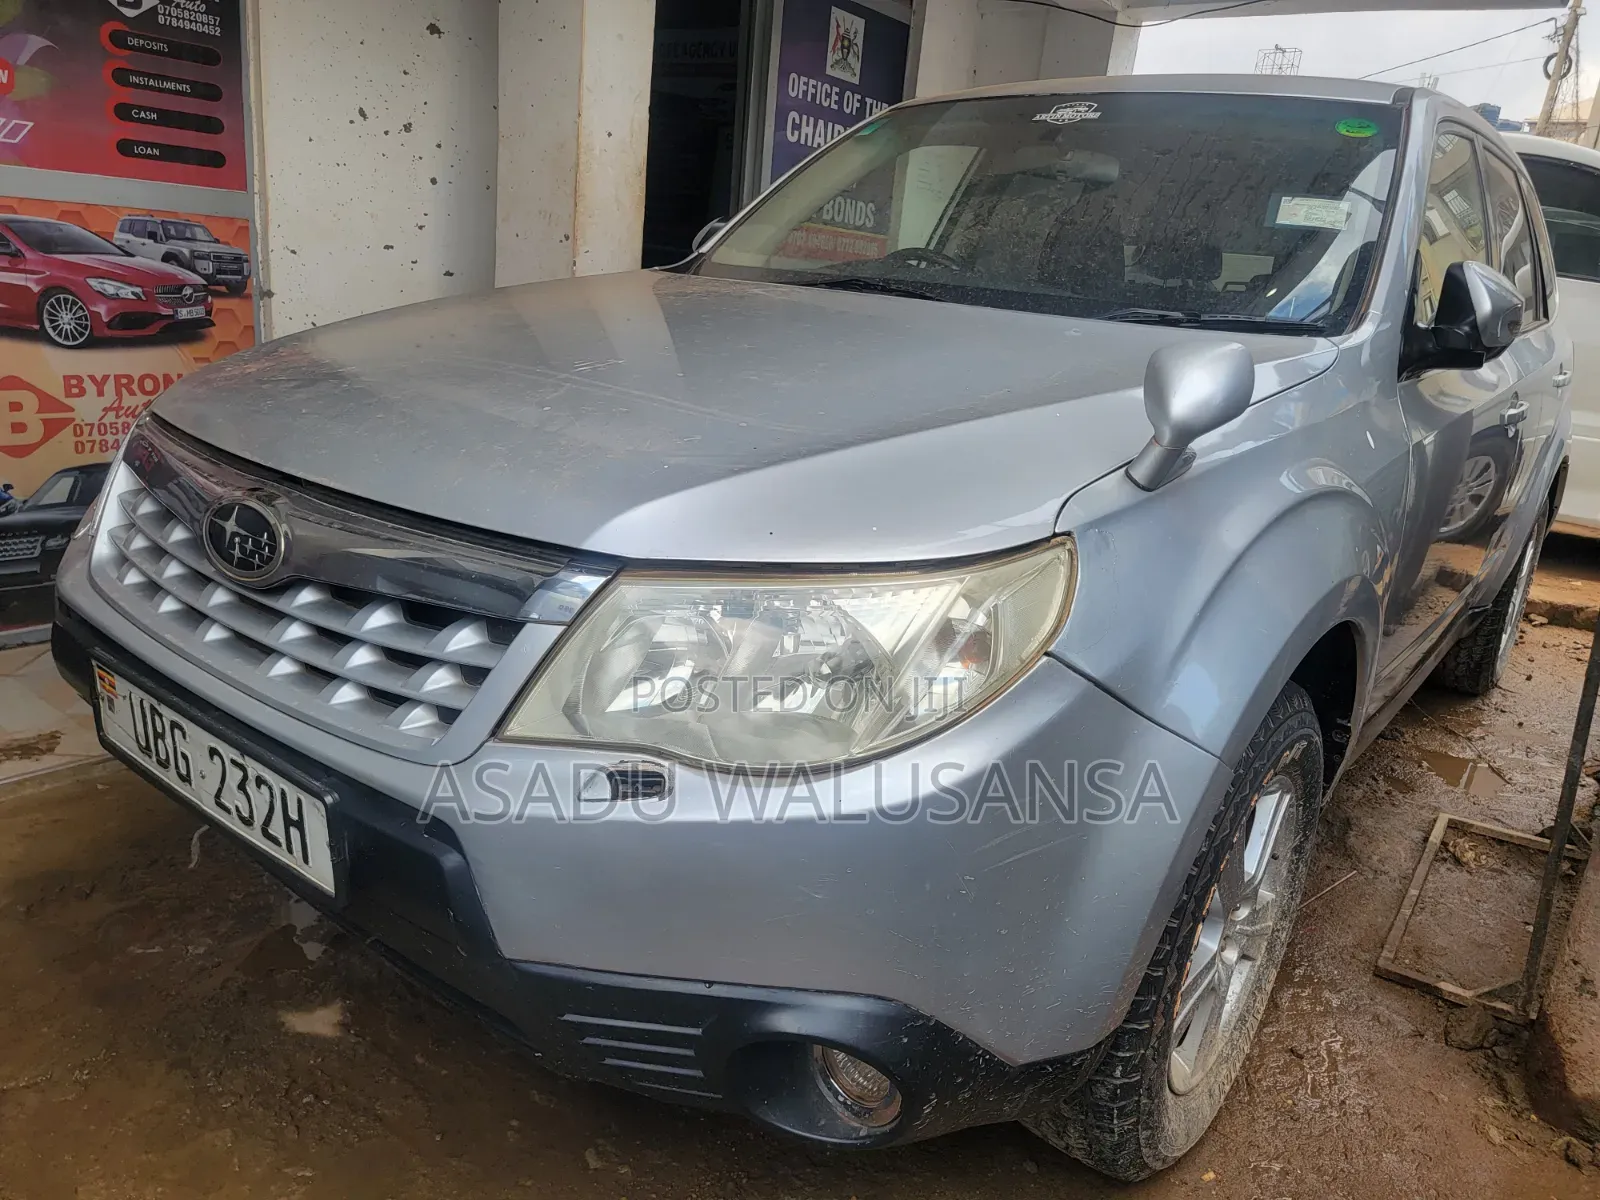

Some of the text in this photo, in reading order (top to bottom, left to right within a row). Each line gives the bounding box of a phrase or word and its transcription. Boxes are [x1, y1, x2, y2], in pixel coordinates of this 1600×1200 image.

[157, 4, 221, 26] 0705820857
[158, 15, 221, 36] 0784940452
[127, 36, 169, 52] DEPOSITS
[129, 75, 191, 93] INSTALLMENTS
[788, 72, 840, 110] OFFICE
[843, 90, 862, 115] OF
[131, 109, 158, 121] CASH
[134, 145, 160, 157] LOAN
[822, 195, 876, 228] BONDS
[128, 688, 312, 867] UBG 232H
